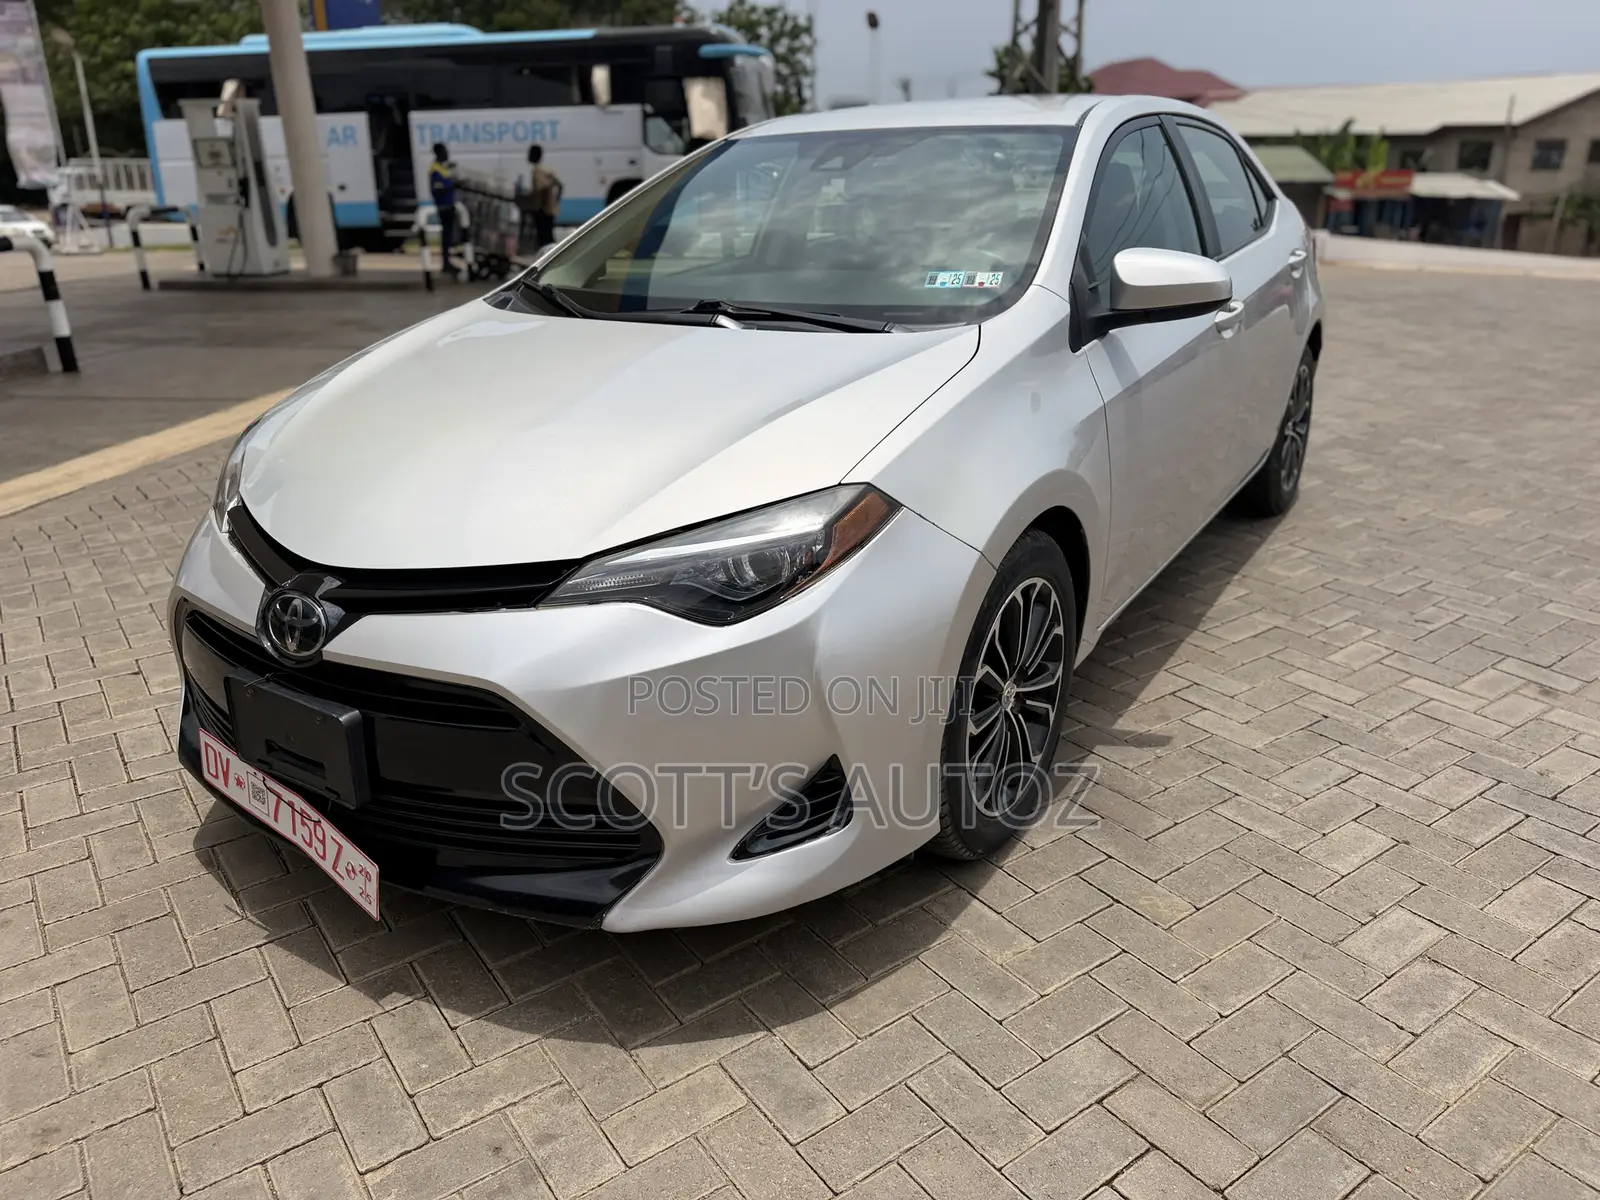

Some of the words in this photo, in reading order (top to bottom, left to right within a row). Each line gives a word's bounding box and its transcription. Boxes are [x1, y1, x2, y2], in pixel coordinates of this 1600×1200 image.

[416, 120, 559, 145] TRANSPORT
[951, 273, 962, 285] 25
[990, 273, 1001, 286] 25
[204, 740, 231, 788] DV
[267, 786, 327, 862] 7159
[331, 834, 345, 881] Z
